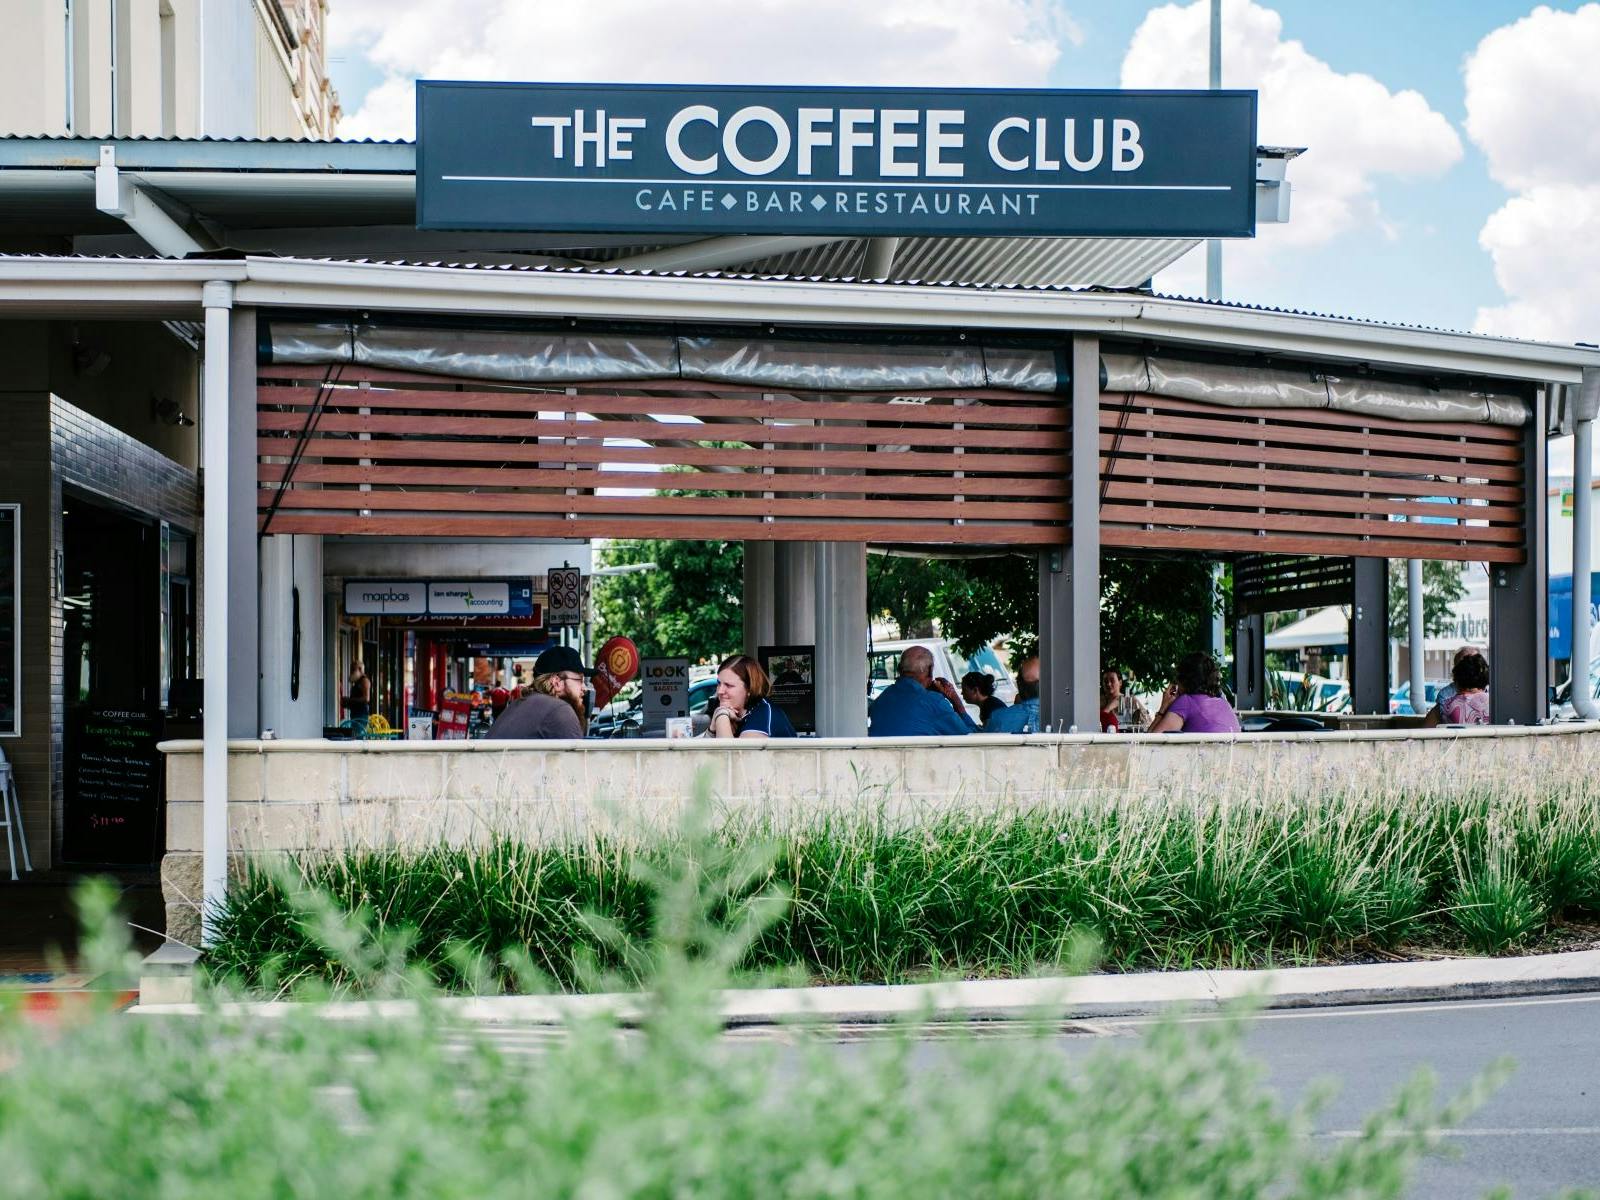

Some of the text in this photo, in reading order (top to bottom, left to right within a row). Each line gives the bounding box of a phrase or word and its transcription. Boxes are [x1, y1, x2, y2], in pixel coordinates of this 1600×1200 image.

[531, 104, 1145, 177] THE COFFEE CLUB
[635, 189, 1041, 215] CAFE BAR RESTAURANT
[469, 598, 504, 608] accounting
[646, 665, 686, 677] LOOK
[102, 710, 129, 718] COFFEE
